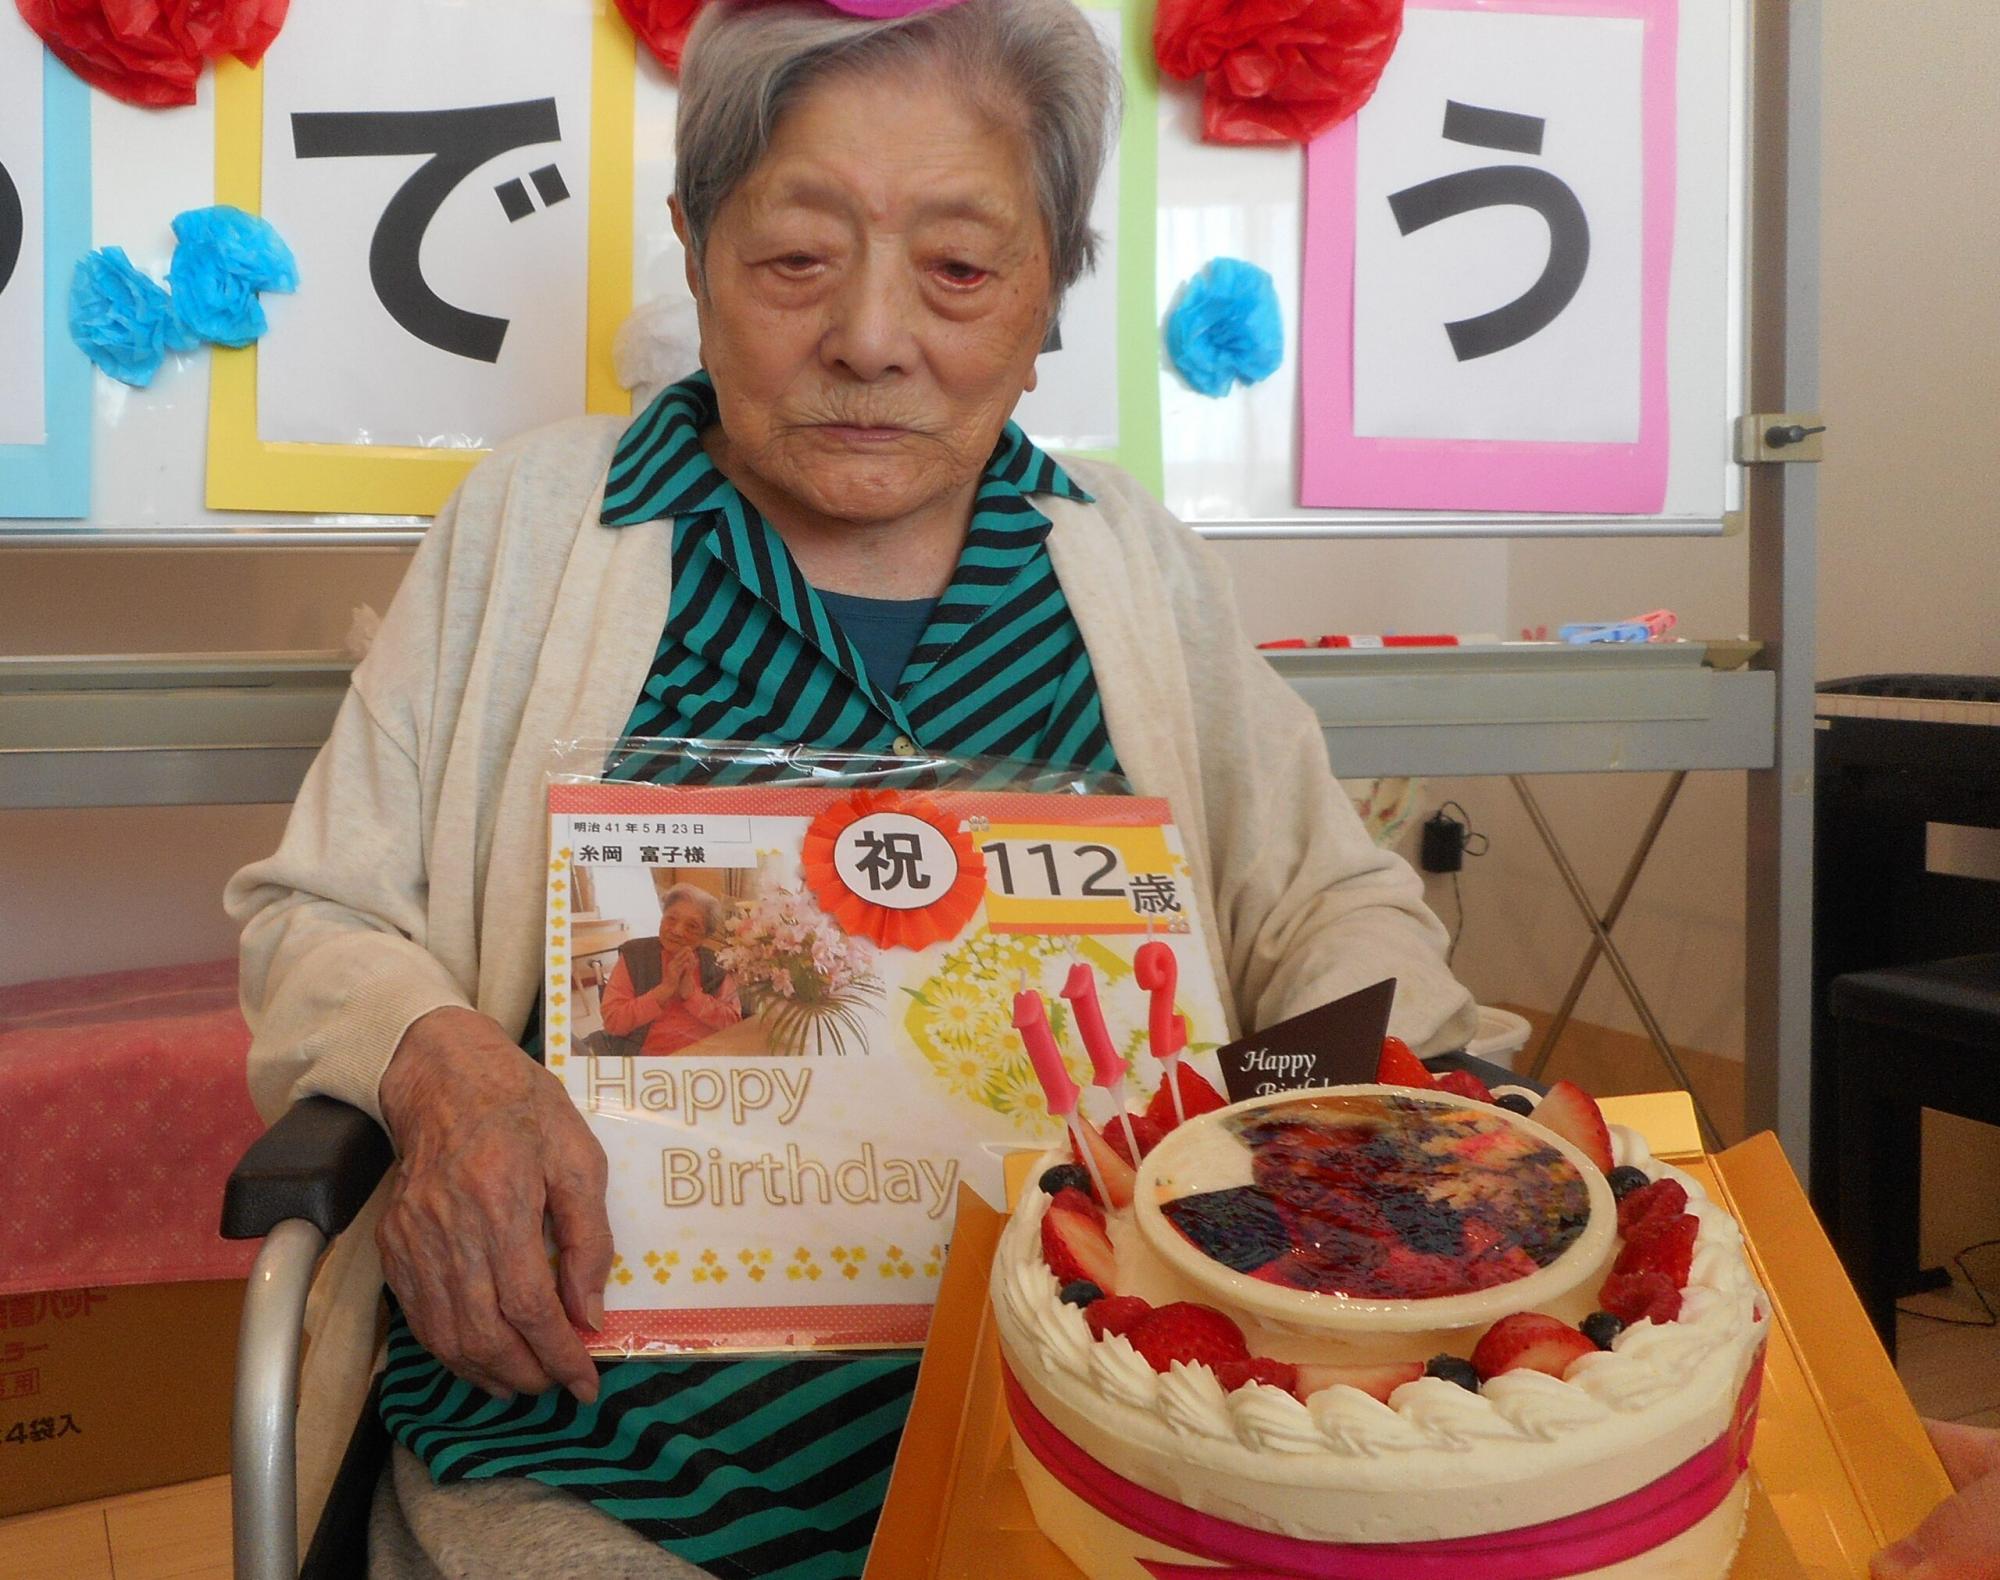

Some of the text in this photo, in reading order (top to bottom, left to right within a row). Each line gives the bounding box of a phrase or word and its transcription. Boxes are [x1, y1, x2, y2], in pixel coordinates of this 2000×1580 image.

[290, 97, 571, 364] で
[1387, 98, 1591, 362] う
[579, 845, 706, 864] 糸岡 富子様
[854, 830, 931, 891] 祝
[586, 1056, 812, 1126] Happy
[1240, 1047, 1317, 1078] Happy
[661, 1142, 959, 1220] Birthday
[0, 1413, 82, 1444] 4袋入
